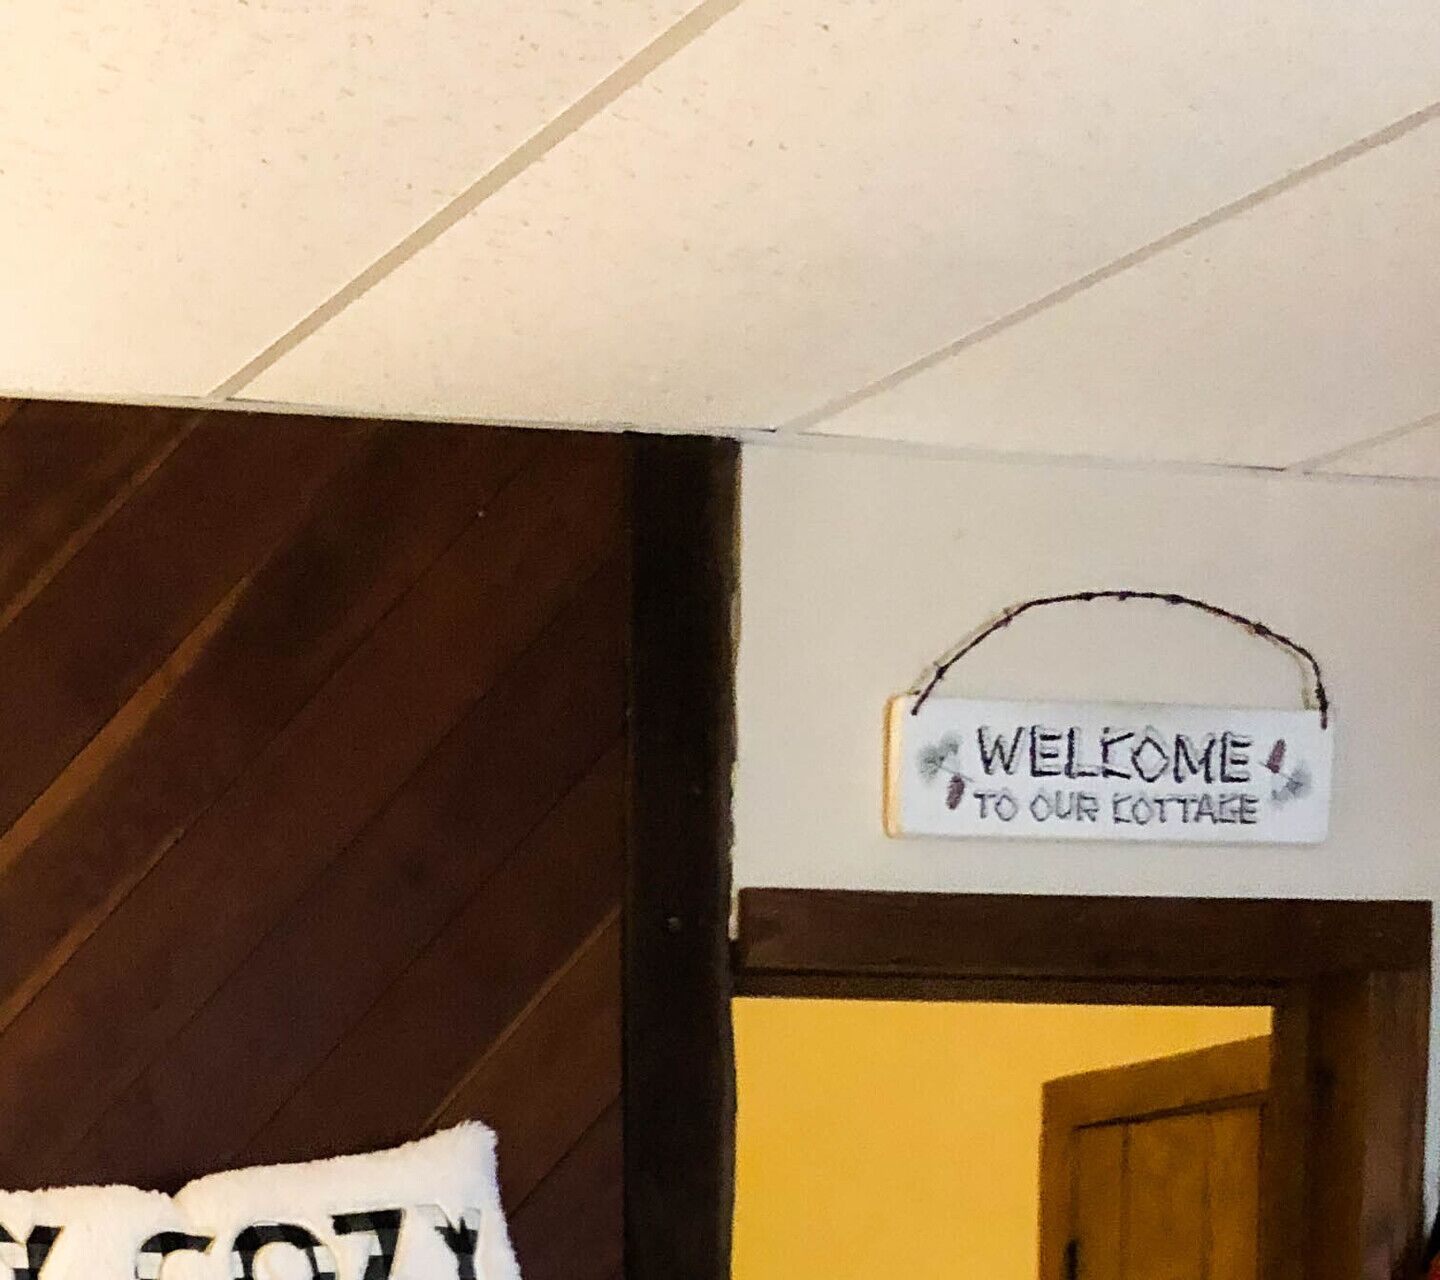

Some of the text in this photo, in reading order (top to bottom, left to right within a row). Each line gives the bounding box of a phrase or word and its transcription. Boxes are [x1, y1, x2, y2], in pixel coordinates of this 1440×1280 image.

[977, 724, 1252, 784] WELCOME
[973, 792, 1259, 826] TO OUR COTTAGE
